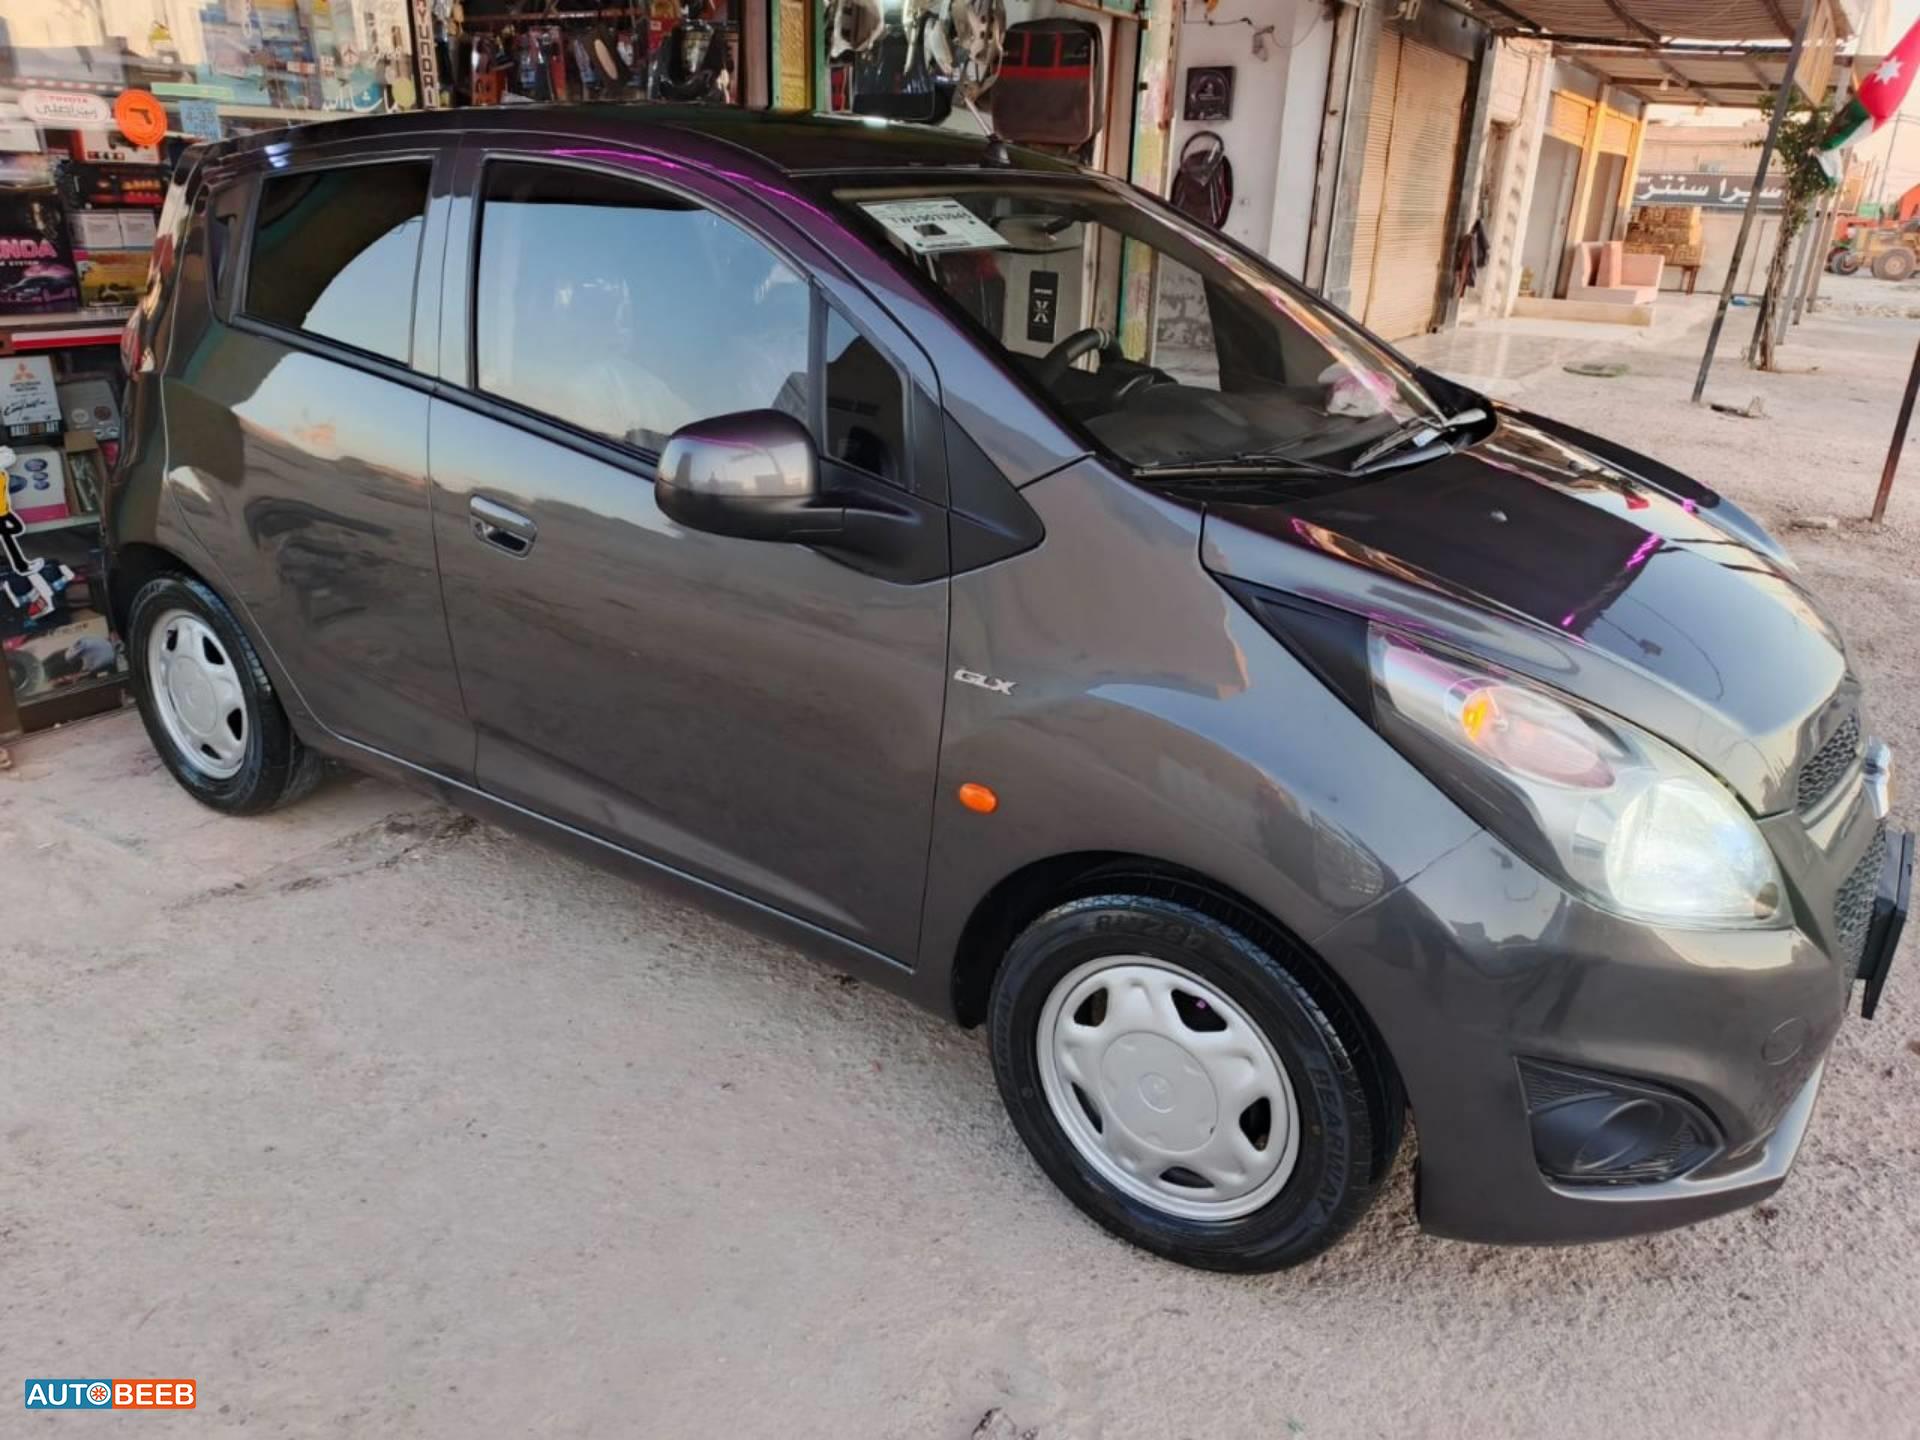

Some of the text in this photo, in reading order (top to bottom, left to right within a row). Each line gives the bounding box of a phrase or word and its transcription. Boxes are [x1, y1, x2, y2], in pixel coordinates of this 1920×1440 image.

[1636, 174, 1783, 202] سرا سنتر
[0, 238, 58, 259] NDA
[953, 668, 1017, 696] GLX
